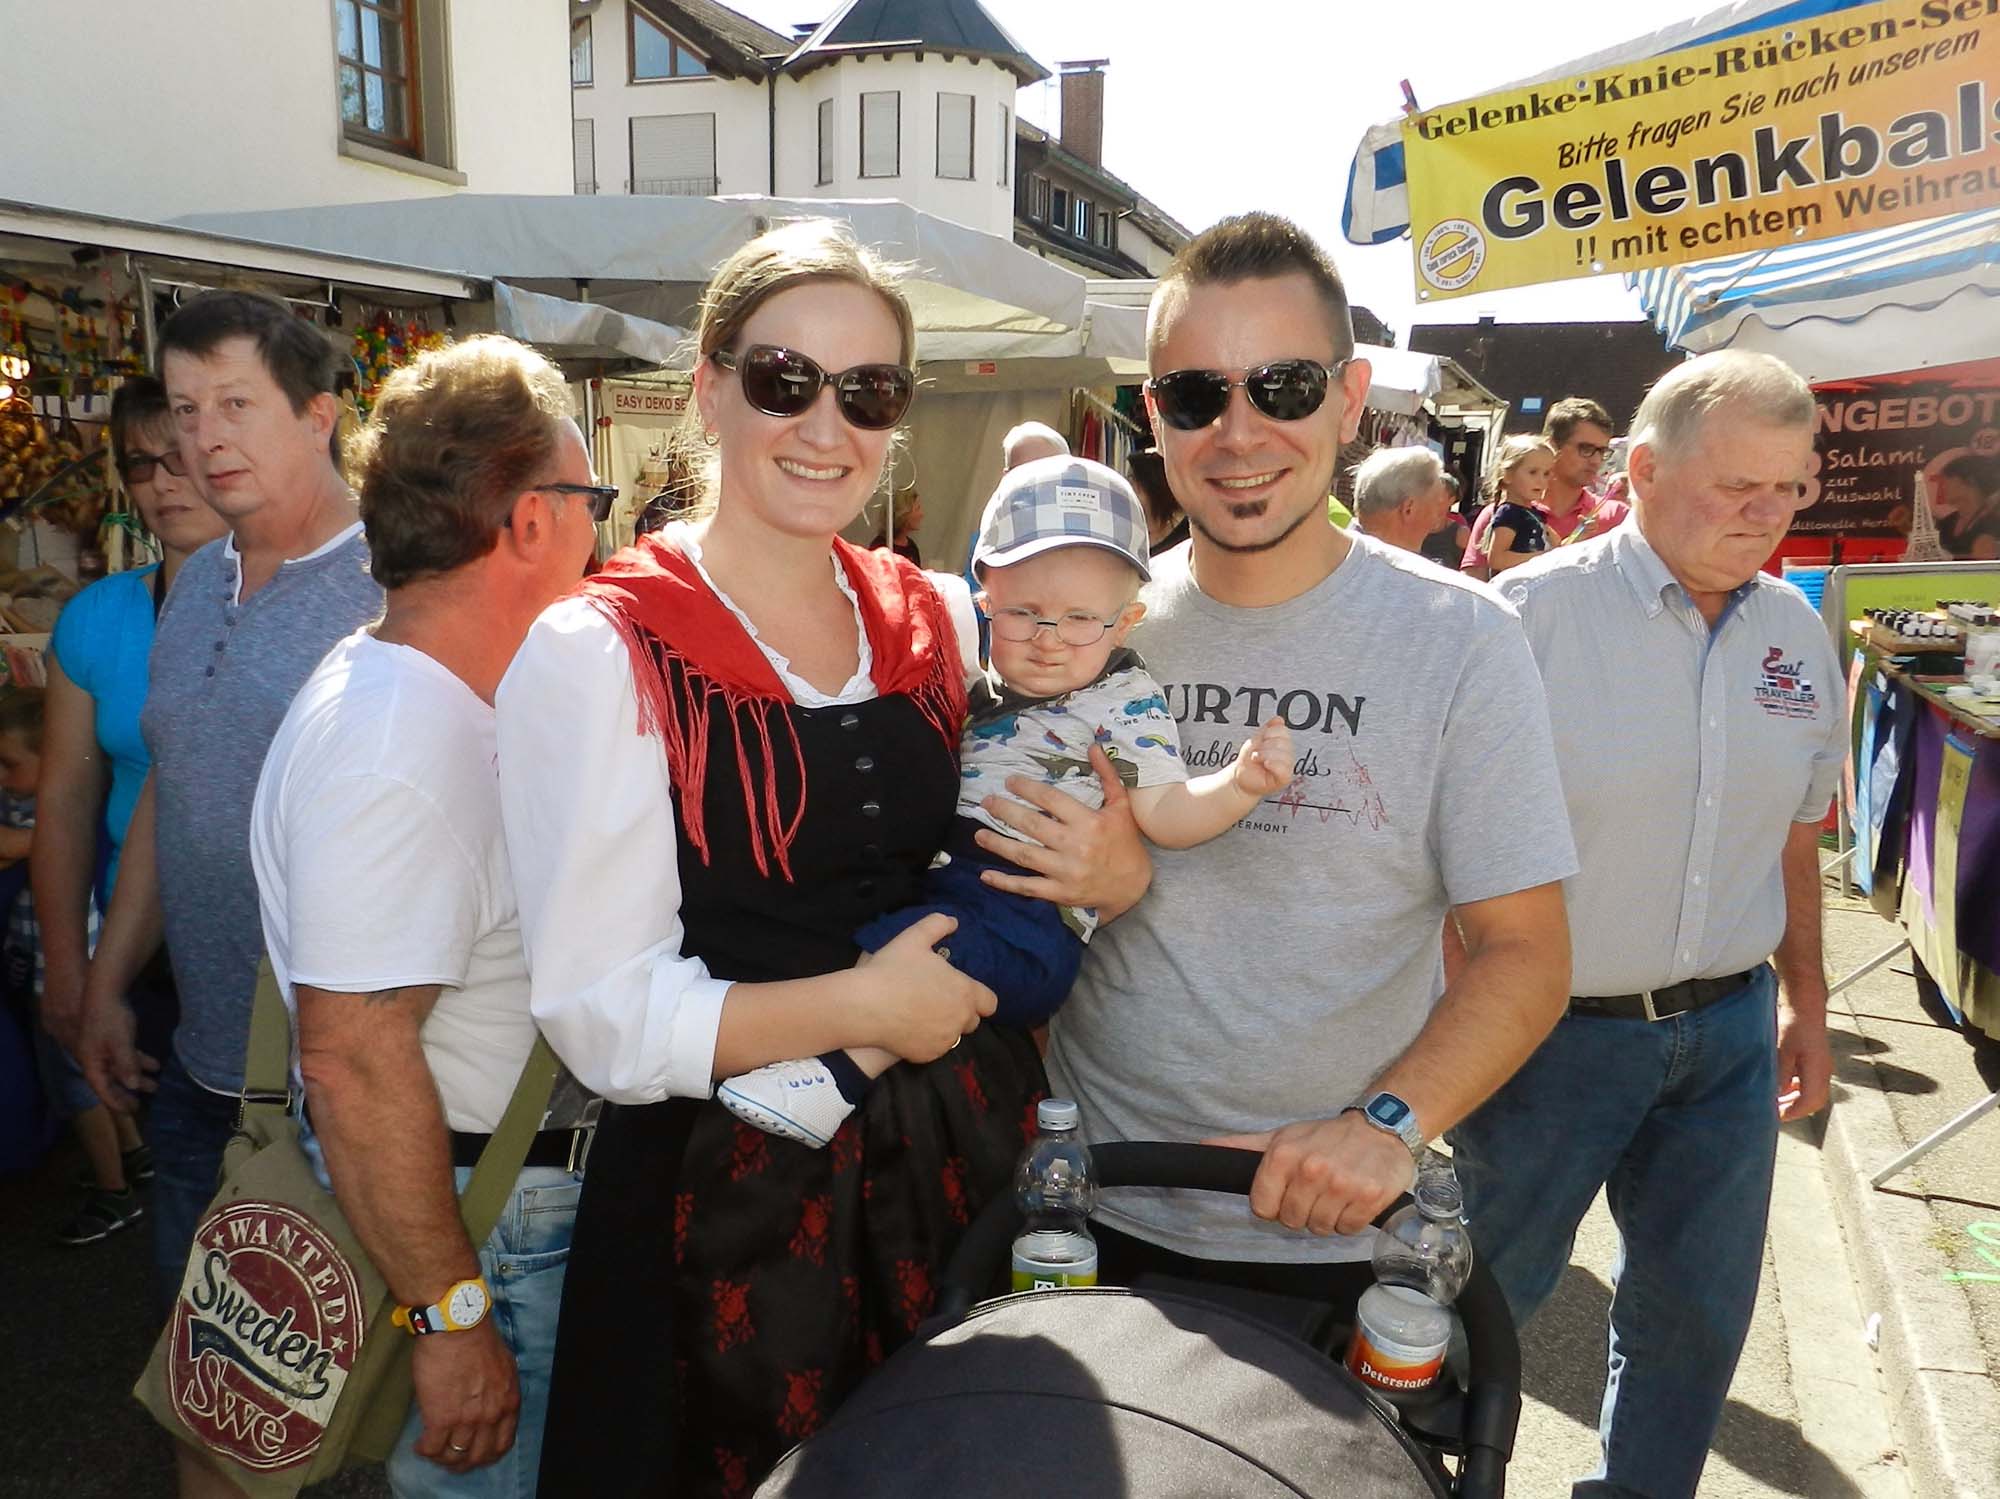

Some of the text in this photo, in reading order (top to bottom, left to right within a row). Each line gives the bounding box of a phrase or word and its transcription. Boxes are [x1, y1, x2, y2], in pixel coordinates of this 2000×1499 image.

[1558, 28, 1981, 170] Bitte fragen Sie nach unserem
[1482, 80, 2000, 240] Gelenkbal
[1576, 236, 1597, 265] !!
[1611, 225, 1669, 260] mit
[1680, 201, 1823, 249] echtem
[616, 394, 643, 409] EASY
[645, 396, 673, 410] DEKO
[1825, 476, 1860, 488] zur
[1826, 445, 1928, 471] Salami
[1823, 487, 1903, 504] Auswahl
[228, 1216, 348, 1327] WANTED
[191, 1249, 330, 1392] Sweden
[183, 1348, 287, 1456] Swe
[1361, 1360, 1433, 1389] Peterstaler
